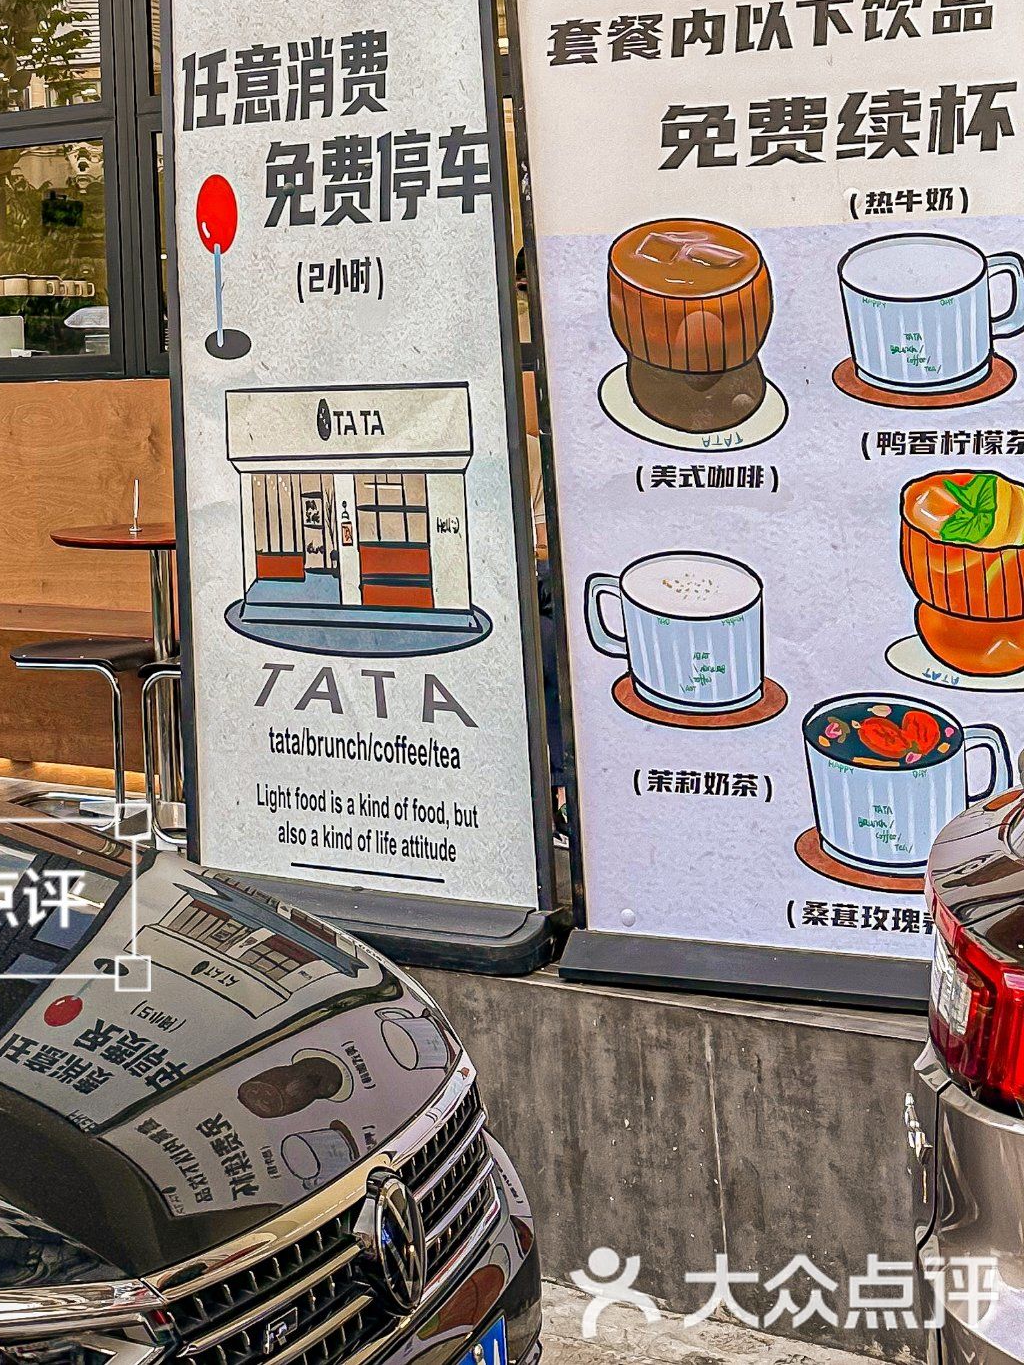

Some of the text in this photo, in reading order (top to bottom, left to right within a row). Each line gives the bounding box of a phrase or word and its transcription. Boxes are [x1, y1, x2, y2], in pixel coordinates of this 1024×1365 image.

[182, 29, 388, 132] 任意消费
[658, 81, 1018, 171] 免费续杯
[264, 125, 493, 229] 免费停车
[850, 187, 969, 220] (热牛奶)
[296, 256, 385, 304] (2小时)
[636, 465, 779, 493] (美式咖啡)
[254, 661, 479, 729] TATA
[268, 726, 462, 770] tata/brunch/coffee/tea
[256, 782, 479, 830] Light food is a kind of food, but
[633, 768, 773, 803] (茉莉奶茶)
[278, 820, 457, 863] also a kind of life attitude
